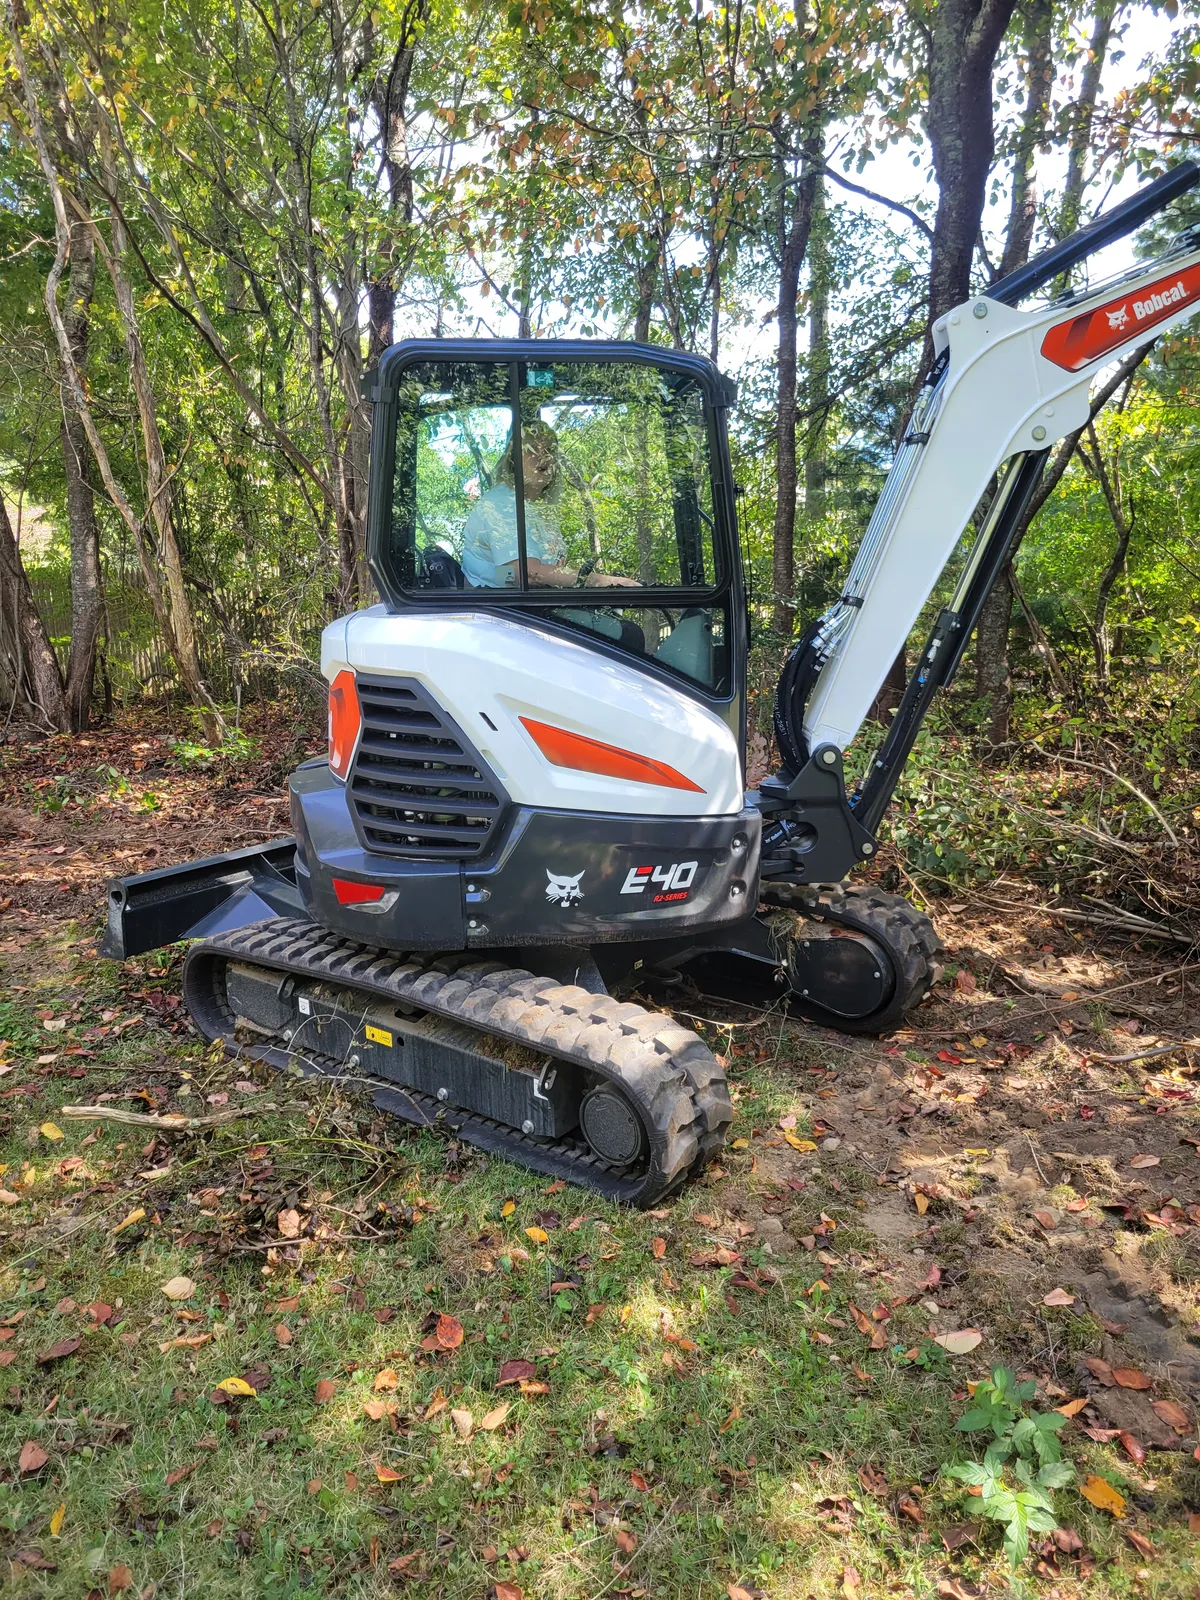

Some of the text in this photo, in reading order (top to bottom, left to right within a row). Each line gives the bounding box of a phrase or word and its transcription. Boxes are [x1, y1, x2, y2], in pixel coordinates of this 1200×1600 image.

[1132, 281, 1187, 320] Bobcat
[620, 861, 699, 894] E40
[653, 891, 688, 903] R2-SERIES
